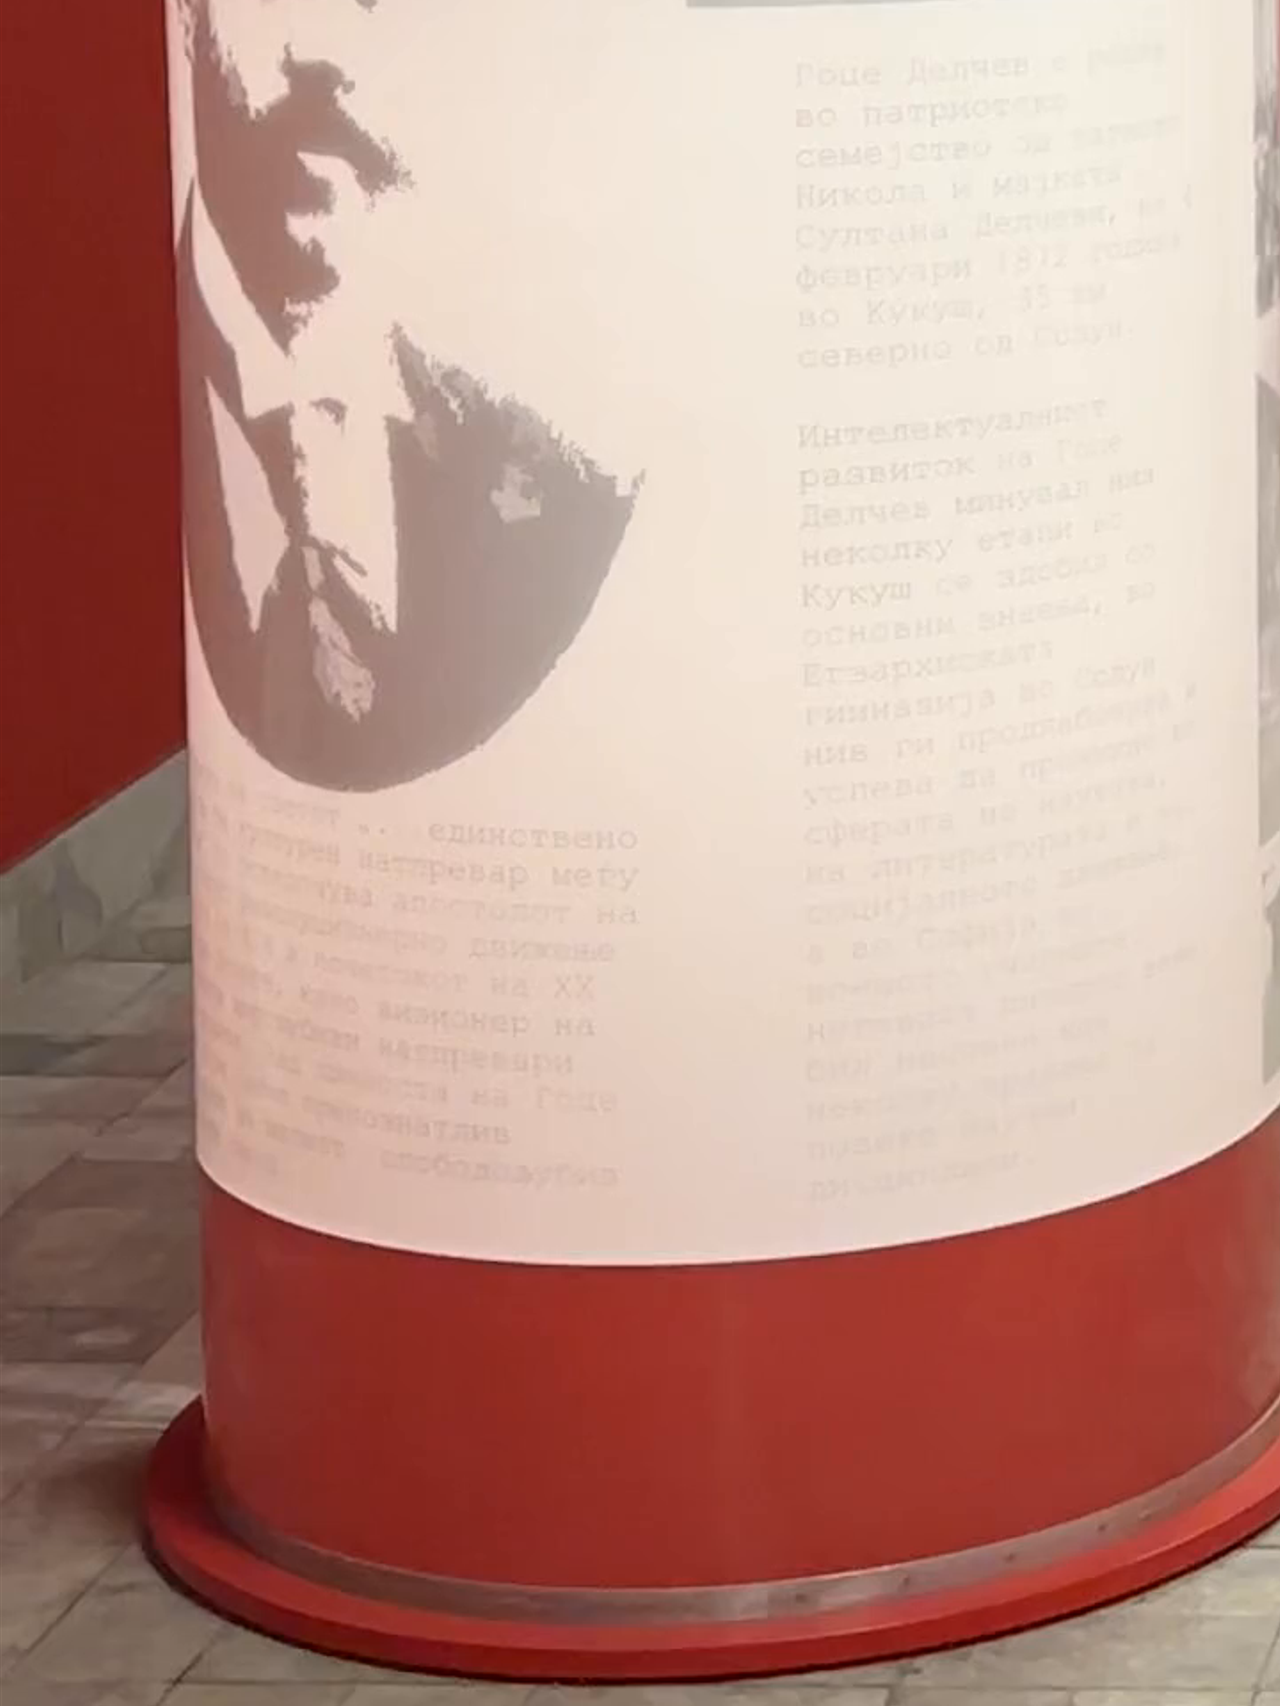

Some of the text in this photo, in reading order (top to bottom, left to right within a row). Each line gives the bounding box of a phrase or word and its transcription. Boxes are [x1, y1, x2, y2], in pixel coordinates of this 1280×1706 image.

[796, 58, 882, 88] Гоце
[908, 55, 1029, 85] Делчев
[795, 104, 837, 130] во
[796, 134, 992, 171] семејство
[796, 181, 929, 210] Никола
[796, 221, 950, 253] Султана
[796, 256, 973, 295] февруари
[798, 306, 840, 328] во
[797, 339, 953, 370] северно
[798, 455, 976, 496] развиток
[800, 496, 932, 532] Делчев
[802, 536, 954, 570] неколку
[802, 579, 912, 614] Кукуш
[802, 615, 958, 648] основни
[805, 687, 996, 728] гимназија
[802, 743, 869, 768] нив
[429, 821, 640, 852] единствено
[596, 903, 641, 927] на
[490, 973, 530, 998] на
[554, 1014, 597, 1038] на
